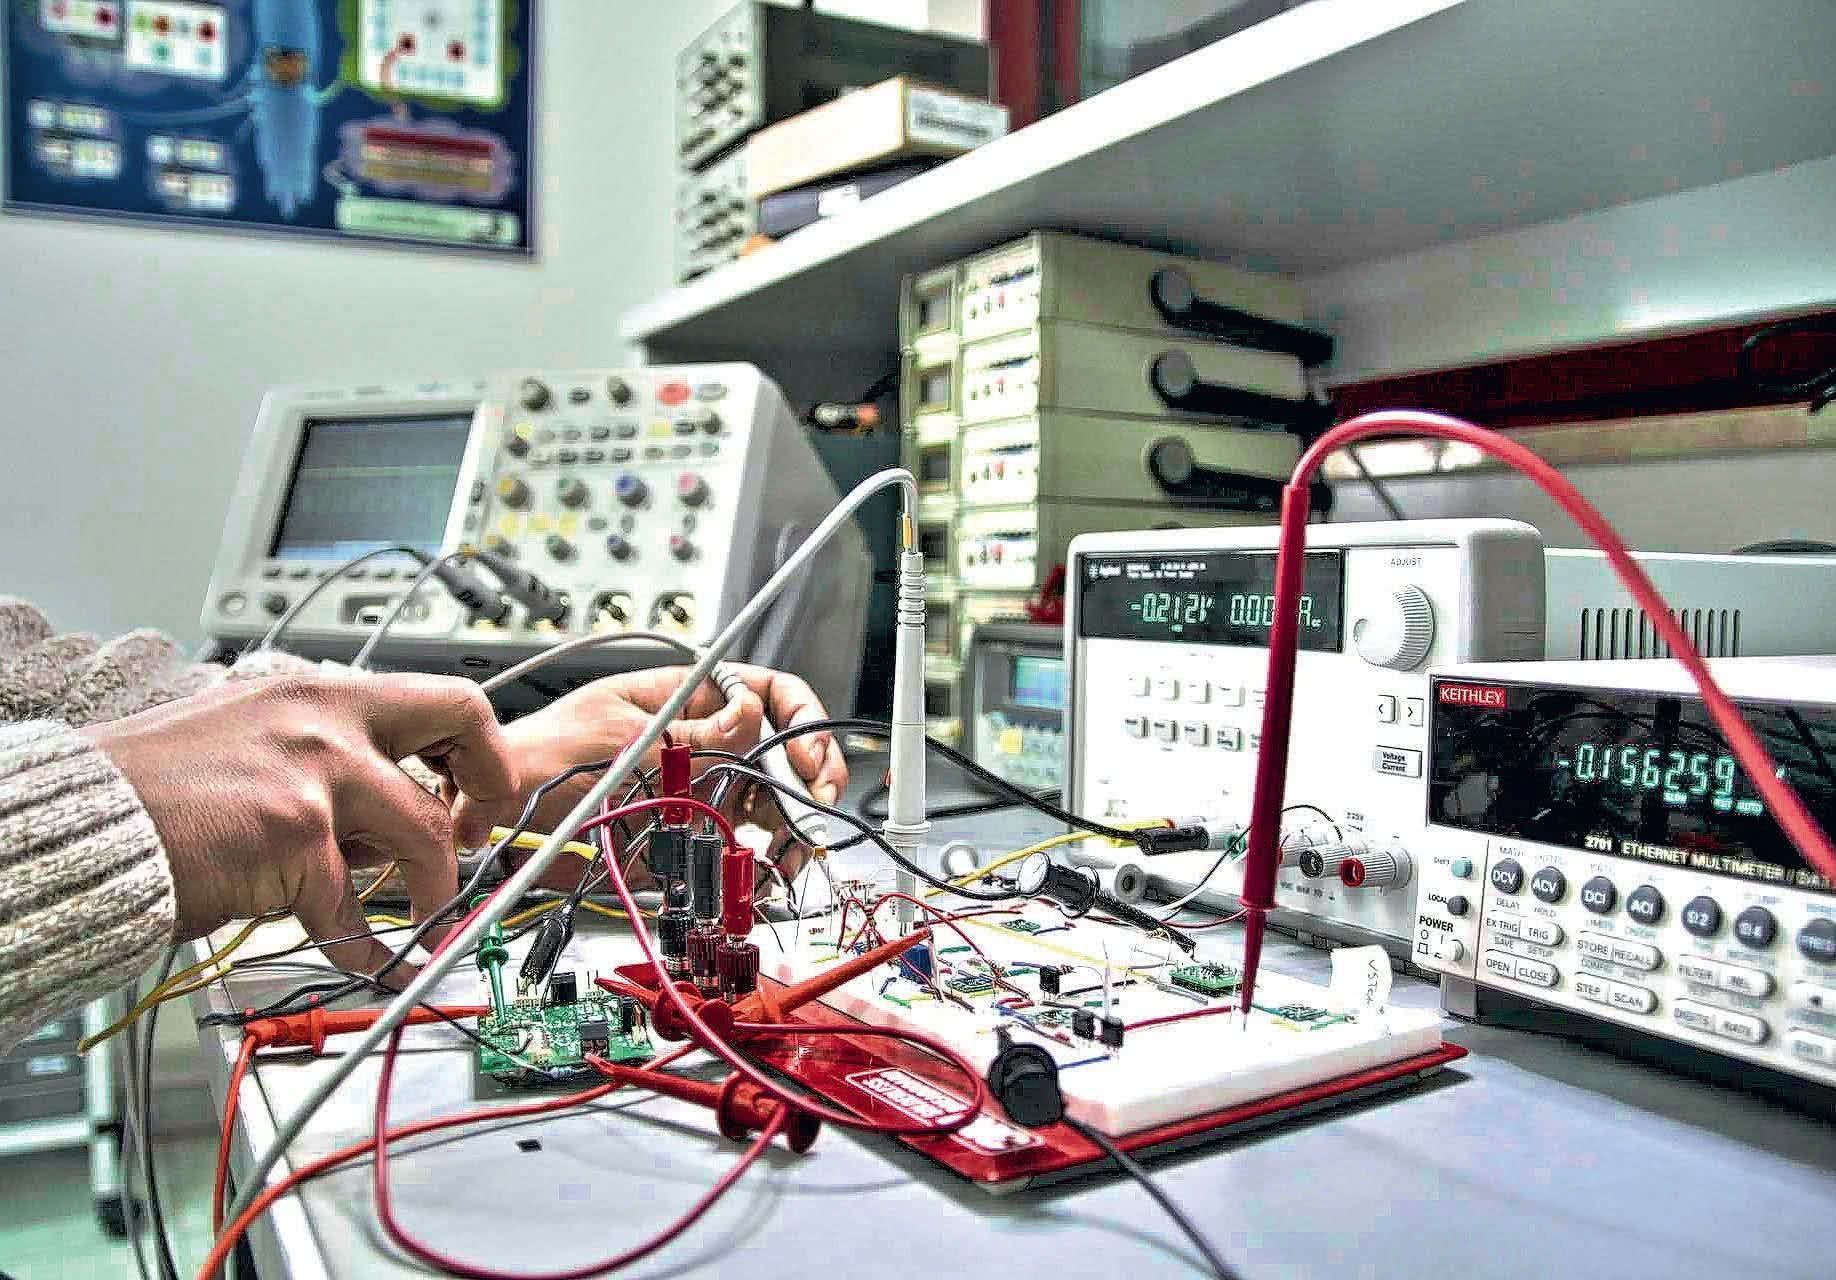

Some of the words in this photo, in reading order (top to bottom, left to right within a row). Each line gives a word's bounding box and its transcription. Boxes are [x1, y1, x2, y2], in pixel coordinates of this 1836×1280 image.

[1390, 557, 1422, 567] ADJUST
[1441, 688, 1501, 704] KEITHLEY
[1382, 751, 1406, 762] Voltage
[1382, 762, 1406, 773] Current
[1584, 834, 1612, 851] 2701
[1622, 841, 1689, 865] ETHERNET
[1690, 851, 1784, 881] MULTIMETER
[1493, 869, 1516, 885] DCV
[1533, 878, 1557, 894] ACV
[1428, 893, 1448, 905] LOCAL
[1496, 897, 1520, 911] DELAY
[1419, 915, 1454, 933] POWER
[1486, 918, 1498, 928] EX
[1499, 920, 1518, 933] TRIG
[1528, 927, 1549, 941] TRIG
[1576, 940, 1609, 956] STORE
[1486, 958, 1510, 974] OPEN
[1519, 968, 1549, 983] CLOSE
[1576, 982, 1601, 996] STEP
[1614, 992, 1644, 1008] SCAN
